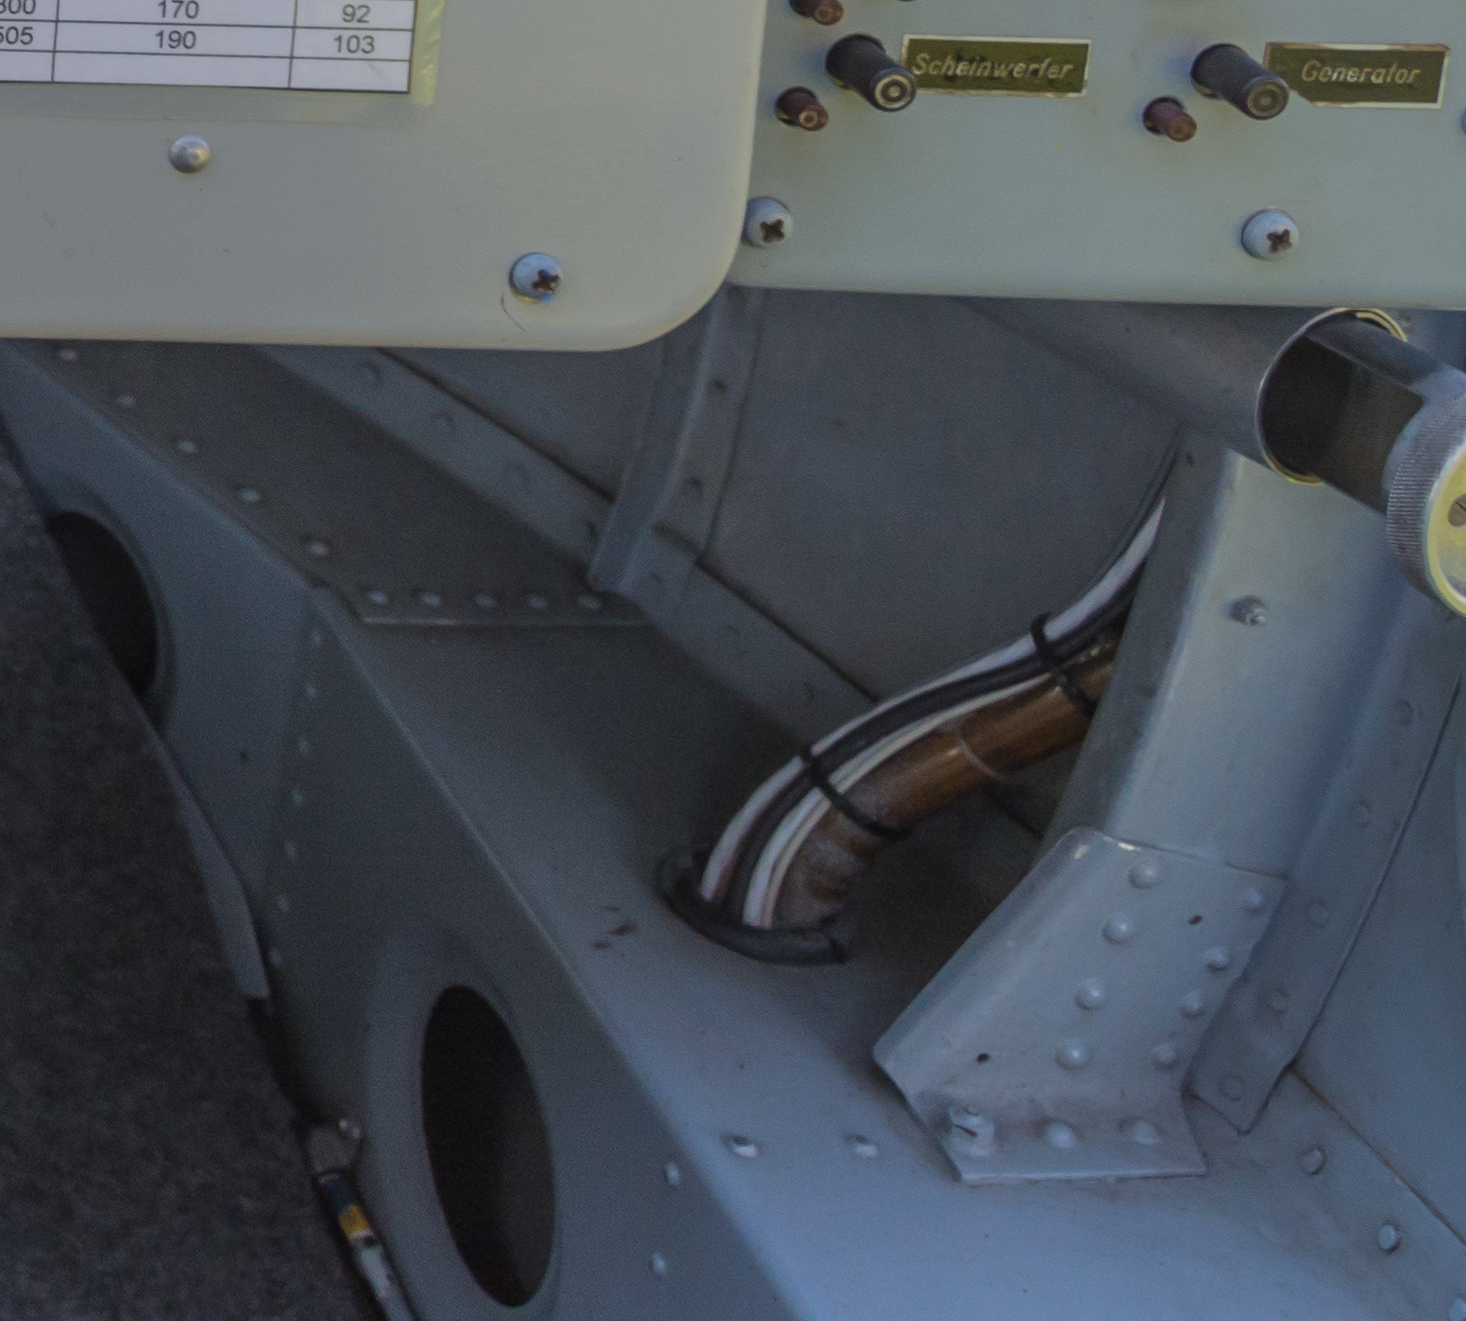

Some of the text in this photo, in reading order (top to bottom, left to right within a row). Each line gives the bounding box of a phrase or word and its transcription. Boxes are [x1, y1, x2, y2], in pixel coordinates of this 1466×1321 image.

[155, 30, 197, 50] 190
[333, 35, 375, 55] 103
[911, 54, 1074, 82] Scheinwerfer
[1301, 61, 1421, 84] Generator
